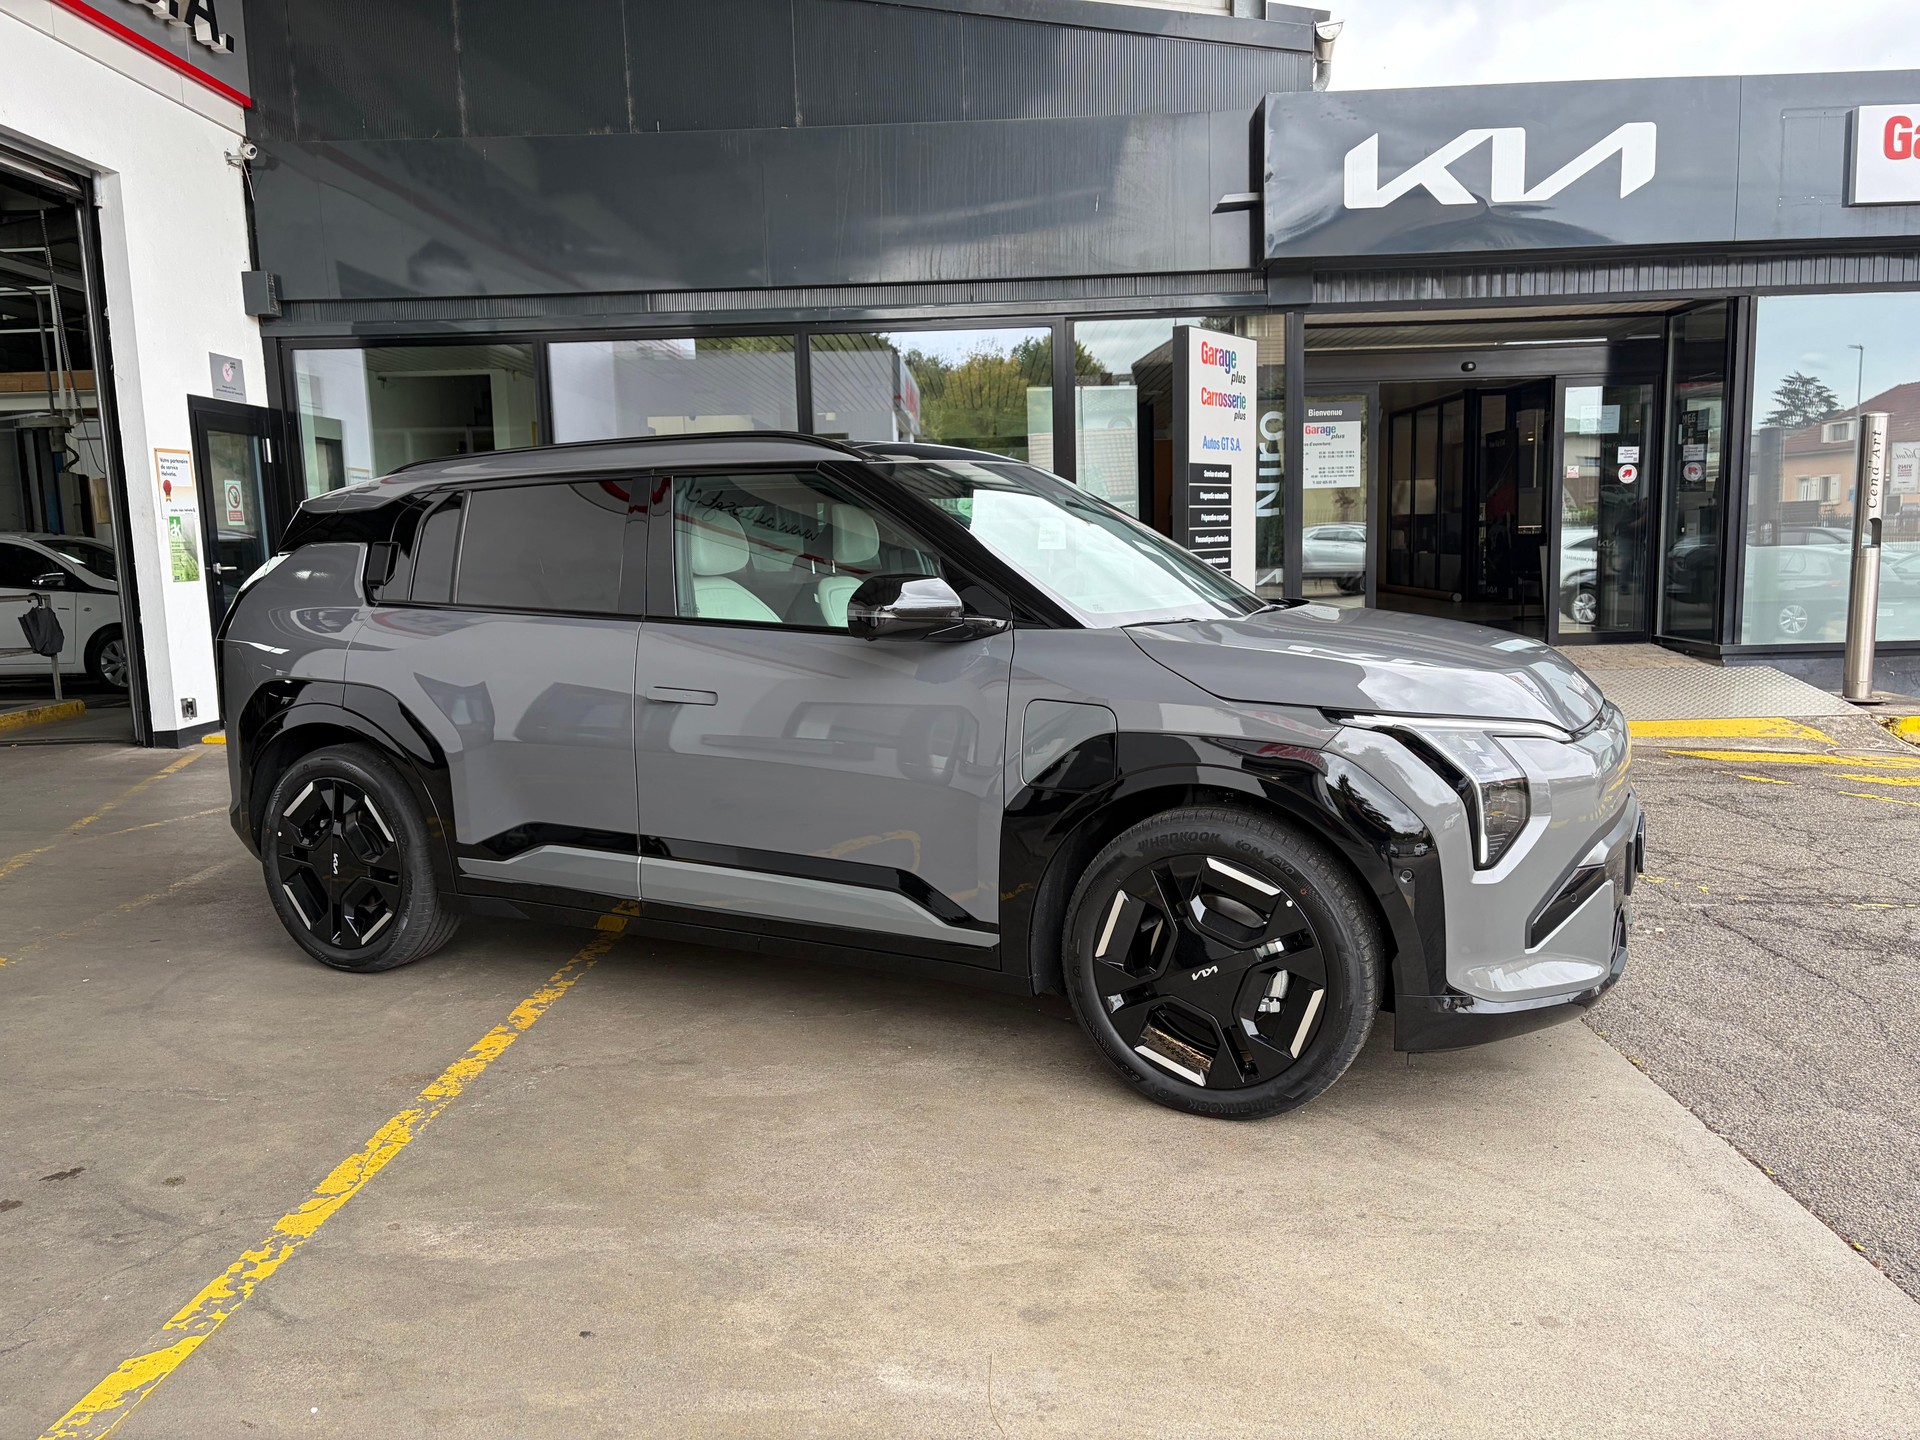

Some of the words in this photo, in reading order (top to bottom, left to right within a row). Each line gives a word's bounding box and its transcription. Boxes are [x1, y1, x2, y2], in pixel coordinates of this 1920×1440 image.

[1201, 341, 1237, 375] Garage
[1231, 371, 1246, 386] plus
[1201, 386, 1247, 410] Carrosserie
[1233, 410, 1246, 422] plus
[1308, 408, 1343, 417] Bienvenue
[1305, 425, 1337, 437] Garage
[1203, 435, 1221, 450] Autos
[1221, 436, 1230, 451] GT
[1230, 438, 1242, 452] S.A.
[1255, 410, 1283, 518] Niro
[1271, 857, 1296, 876] evo
